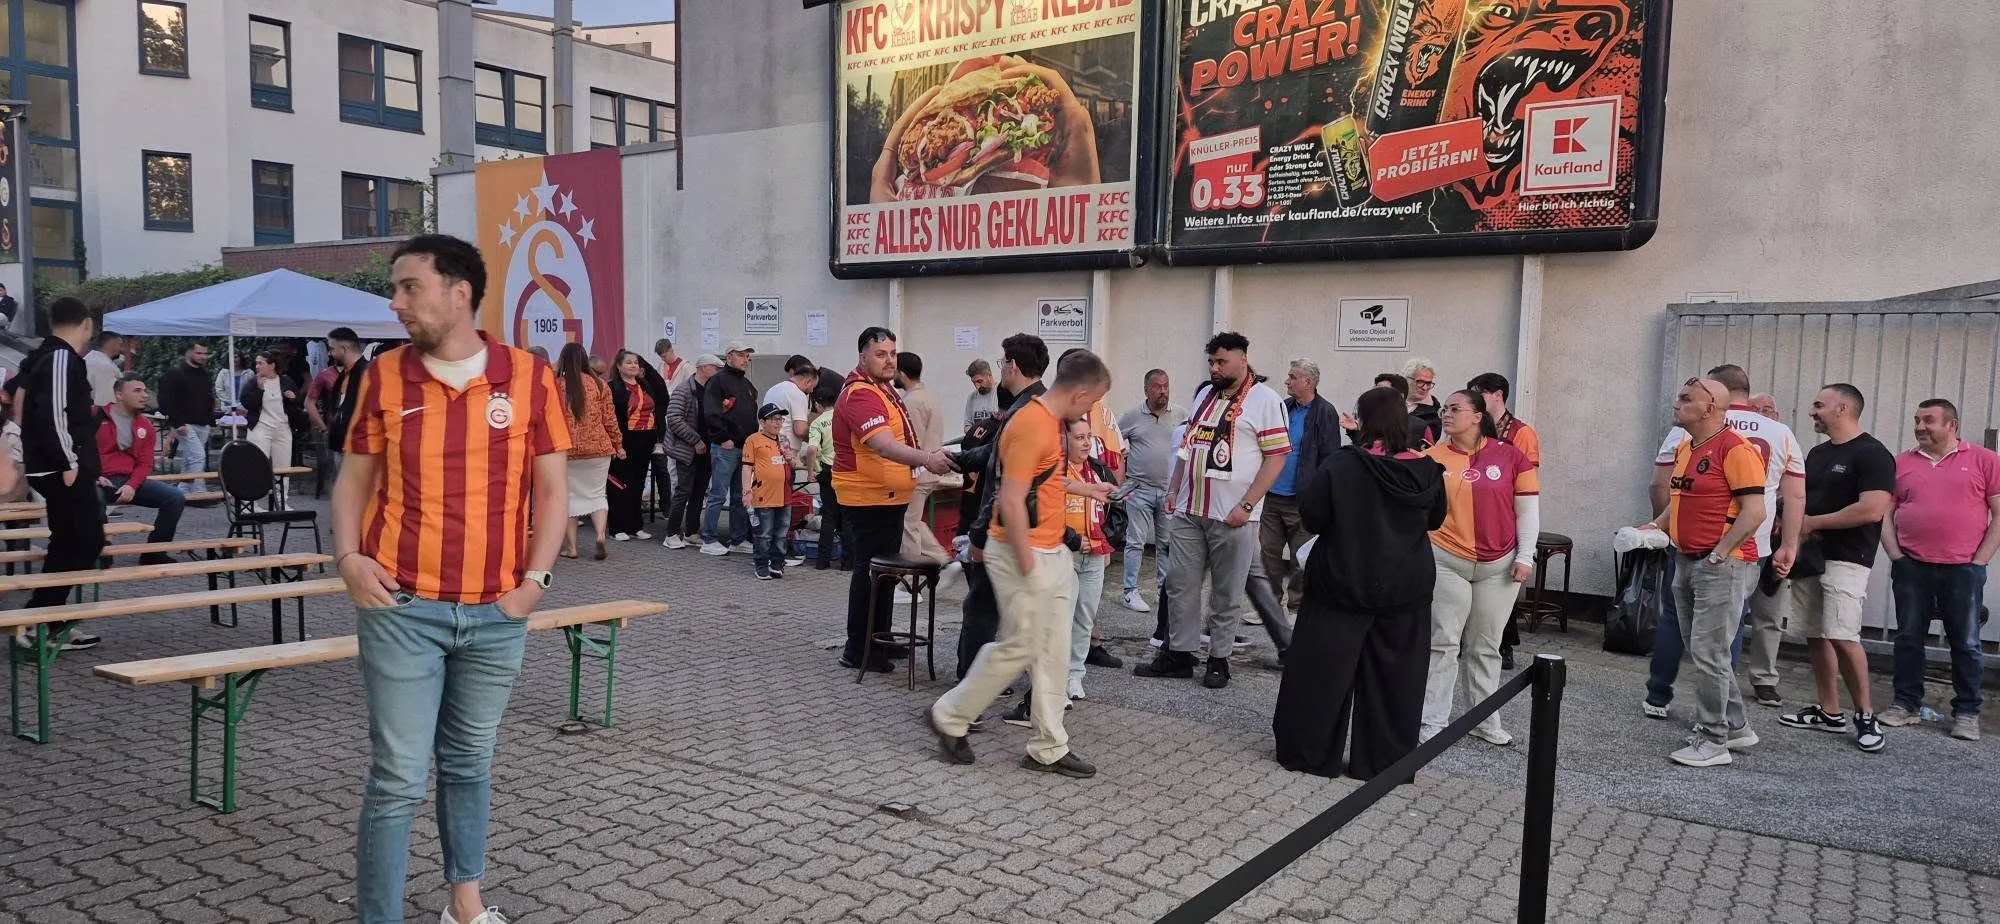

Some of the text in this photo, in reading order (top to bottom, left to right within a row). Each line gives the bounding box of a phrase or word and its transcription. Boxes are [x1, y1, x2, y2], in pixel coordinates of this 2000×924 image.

[846, 3, 888, 55] KFC
[847, 61, 861, 70] KFC
[863, 58, 878, 67] KFC
[880, 55, 896, 64] KFC
[898, 53, 914, 62] KFC
[916, 50, 932, 59] KFC
[934, 47, 950, 56] KFC
[952, 44, 969, 52] KFC
[990, 37, 1007, 46] KFC
[1009, 33, 1027, 42] KFC
[1030, 29, 1048, 39] KFC
[1051, 25, 1069, 35] KFC
[1072, 22, 1091, 31] KFC
[1094, 18, 1113, 28] KFC
[1116, 13, 1136, 25] KFC
[1190, 15, 1361, 97] POWER!
[1374, 52, 1400, 119] CRAZY
[1401, 89, 1437, 98] ENERGY
[1399, 98, 1429, 107] DRINK
[1190, 135, 1259, 157] KNÜLLER-PREIS
[1270, 143, 1315, 153] CRAZY WOLF
[1401, 139, 1450, 162] JETZT
[1269, 155, 1291, 163] Energy
[1285, 162, 1307, 170] Strong
[1376, 148, 1479, 181] PROBIEREN!
[1226, 162, 1248, 174] nur
[1534, 160, 1603, 176] Kaufland
[1097, 191, 1130, 206] KFC
[1193, 174, 1264, 208] 0.33
[1518, 202, 1541, 212] Hier
[1542, 200, 1559, 210] bin
[1579, 198, 1615, 209] richtig
[846, 212, 871, 225] KFC
[1097, 209, 1129, 224] KFC
[1184, 215, 1225, 227] Weitere
[1227, 213, 1254, 224] Infos
[1256, 210, 1285, 223] unter
[1288, 202, 1422, 220] kaufland.de/crazywolf
[874, 193, 1091, 254] ALLES NUR GEKLAUT
[846, 227, 871, 240] KFC
[1097, 227, 1129, 242] KFC
[846, 242, 870, 256] KFC
[746, 313, 777, 321] Parkverbot
[1040, 318, 1083, 327] Parkverbot
[534, 318, 558, 332] 1905
